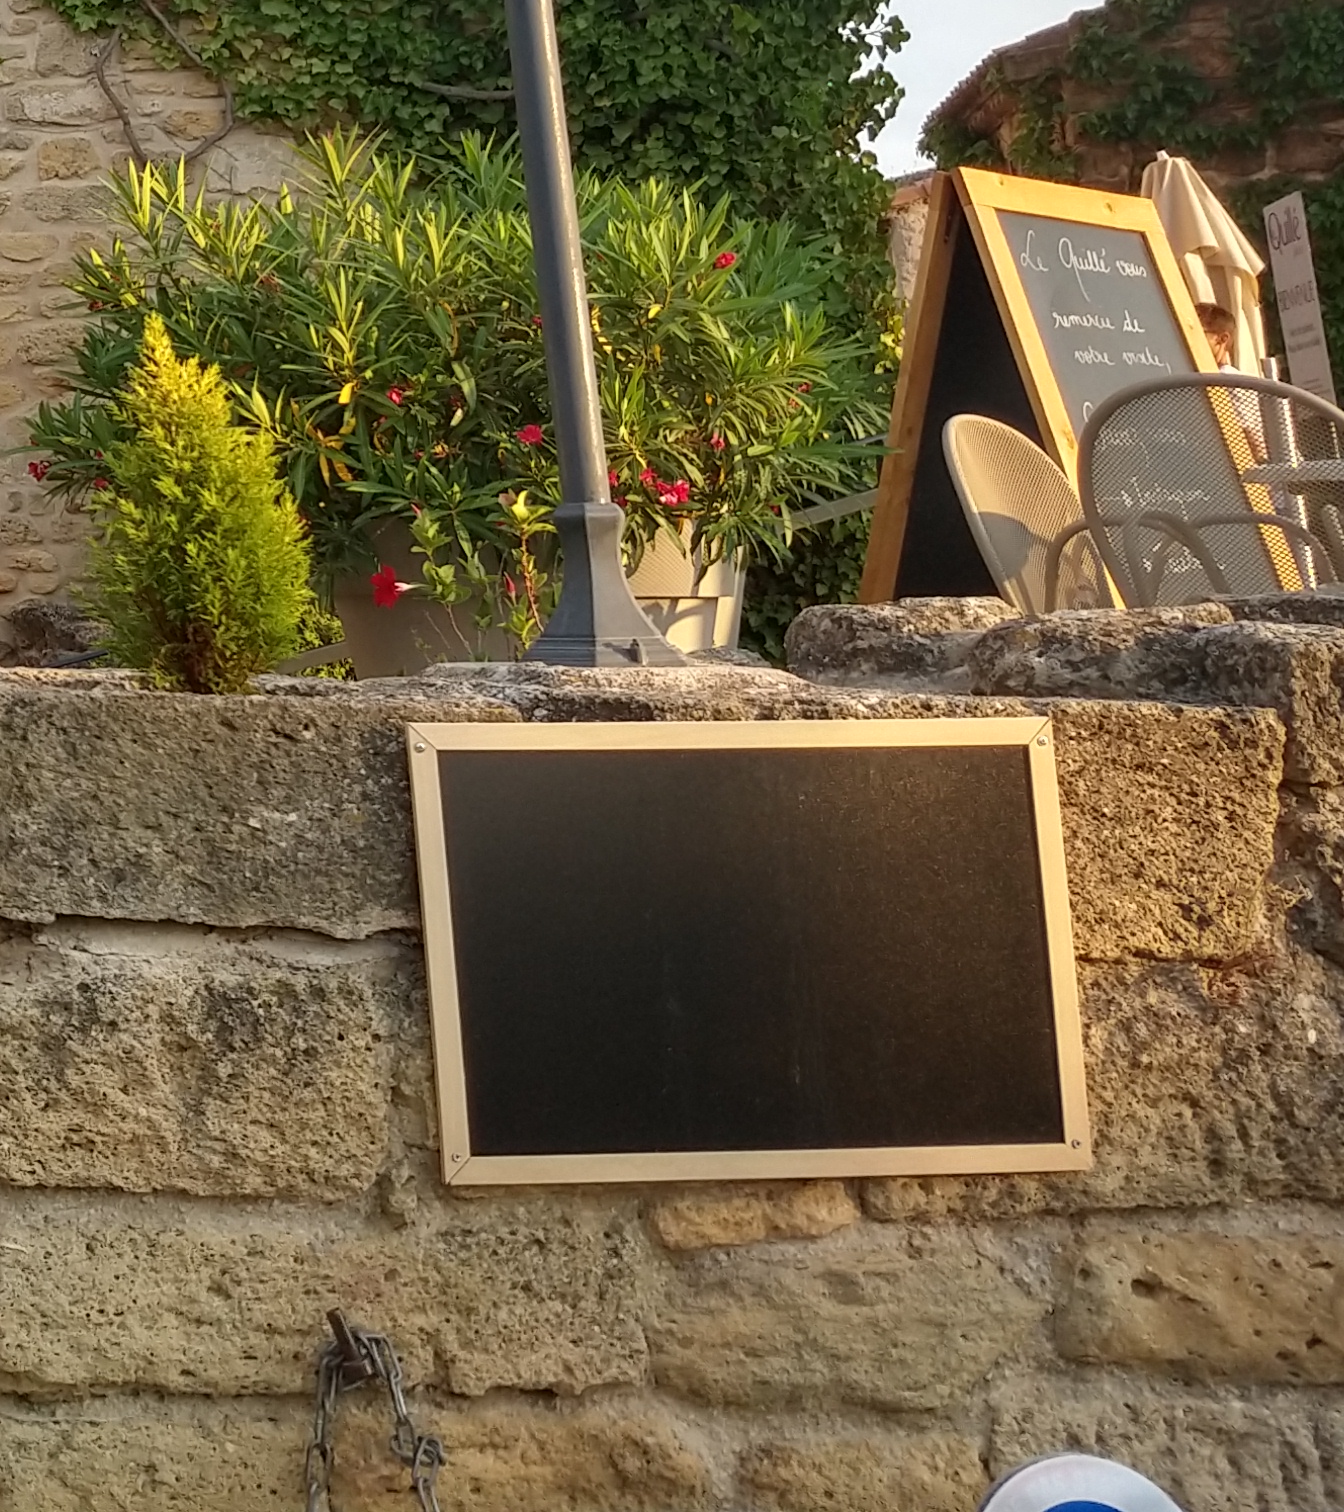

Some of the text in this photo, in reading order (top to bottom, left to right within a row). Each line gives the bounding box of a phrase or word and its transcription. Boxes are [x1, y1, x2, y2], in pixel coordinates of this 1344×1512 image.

[1020, 230, 1147, 302] Le Quillé vous
[1123, 310, 1145, 333] de
[1074, 345, 1116, 365] votre
